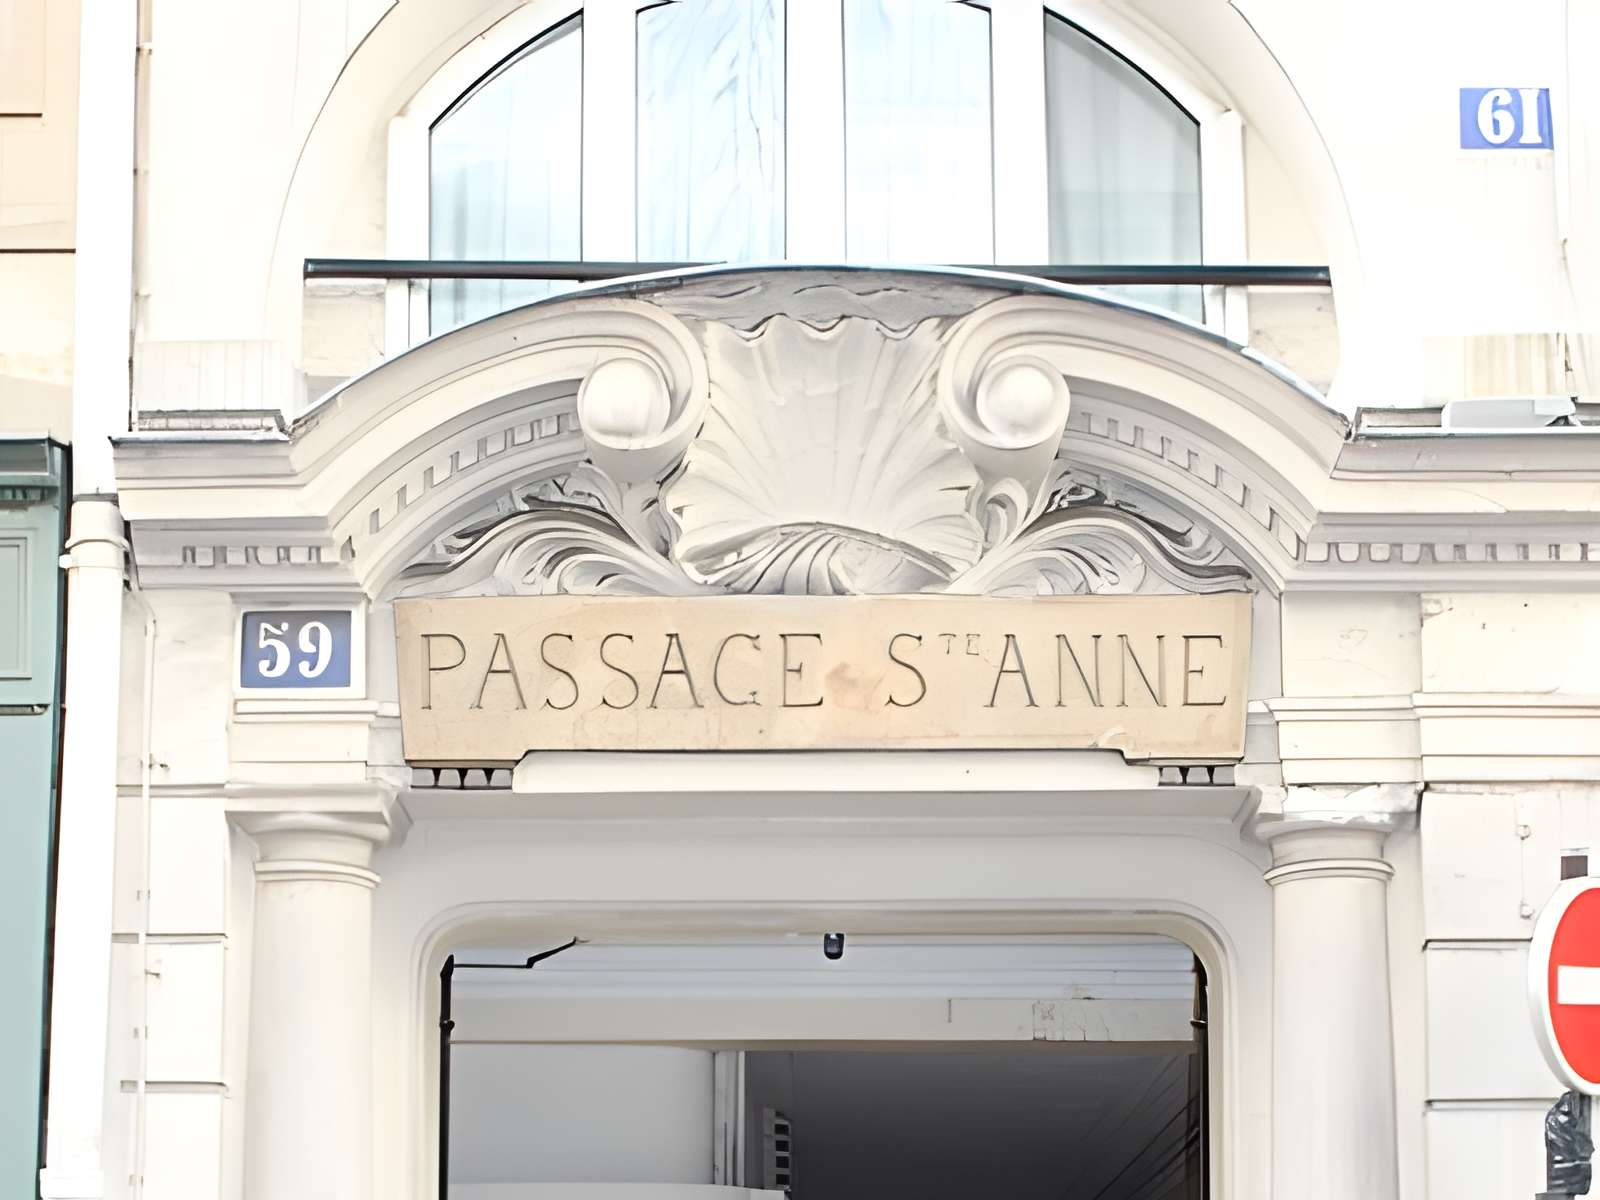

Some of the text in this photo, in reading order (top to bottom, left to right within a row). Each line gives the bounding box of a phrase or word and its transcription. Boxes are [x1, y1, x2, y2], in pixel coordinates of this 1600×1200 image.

[1477, 87, 1543, 145] 61
[257, 620, 333, 679] 59
[420, 632, 824, 710] PASSAGE
